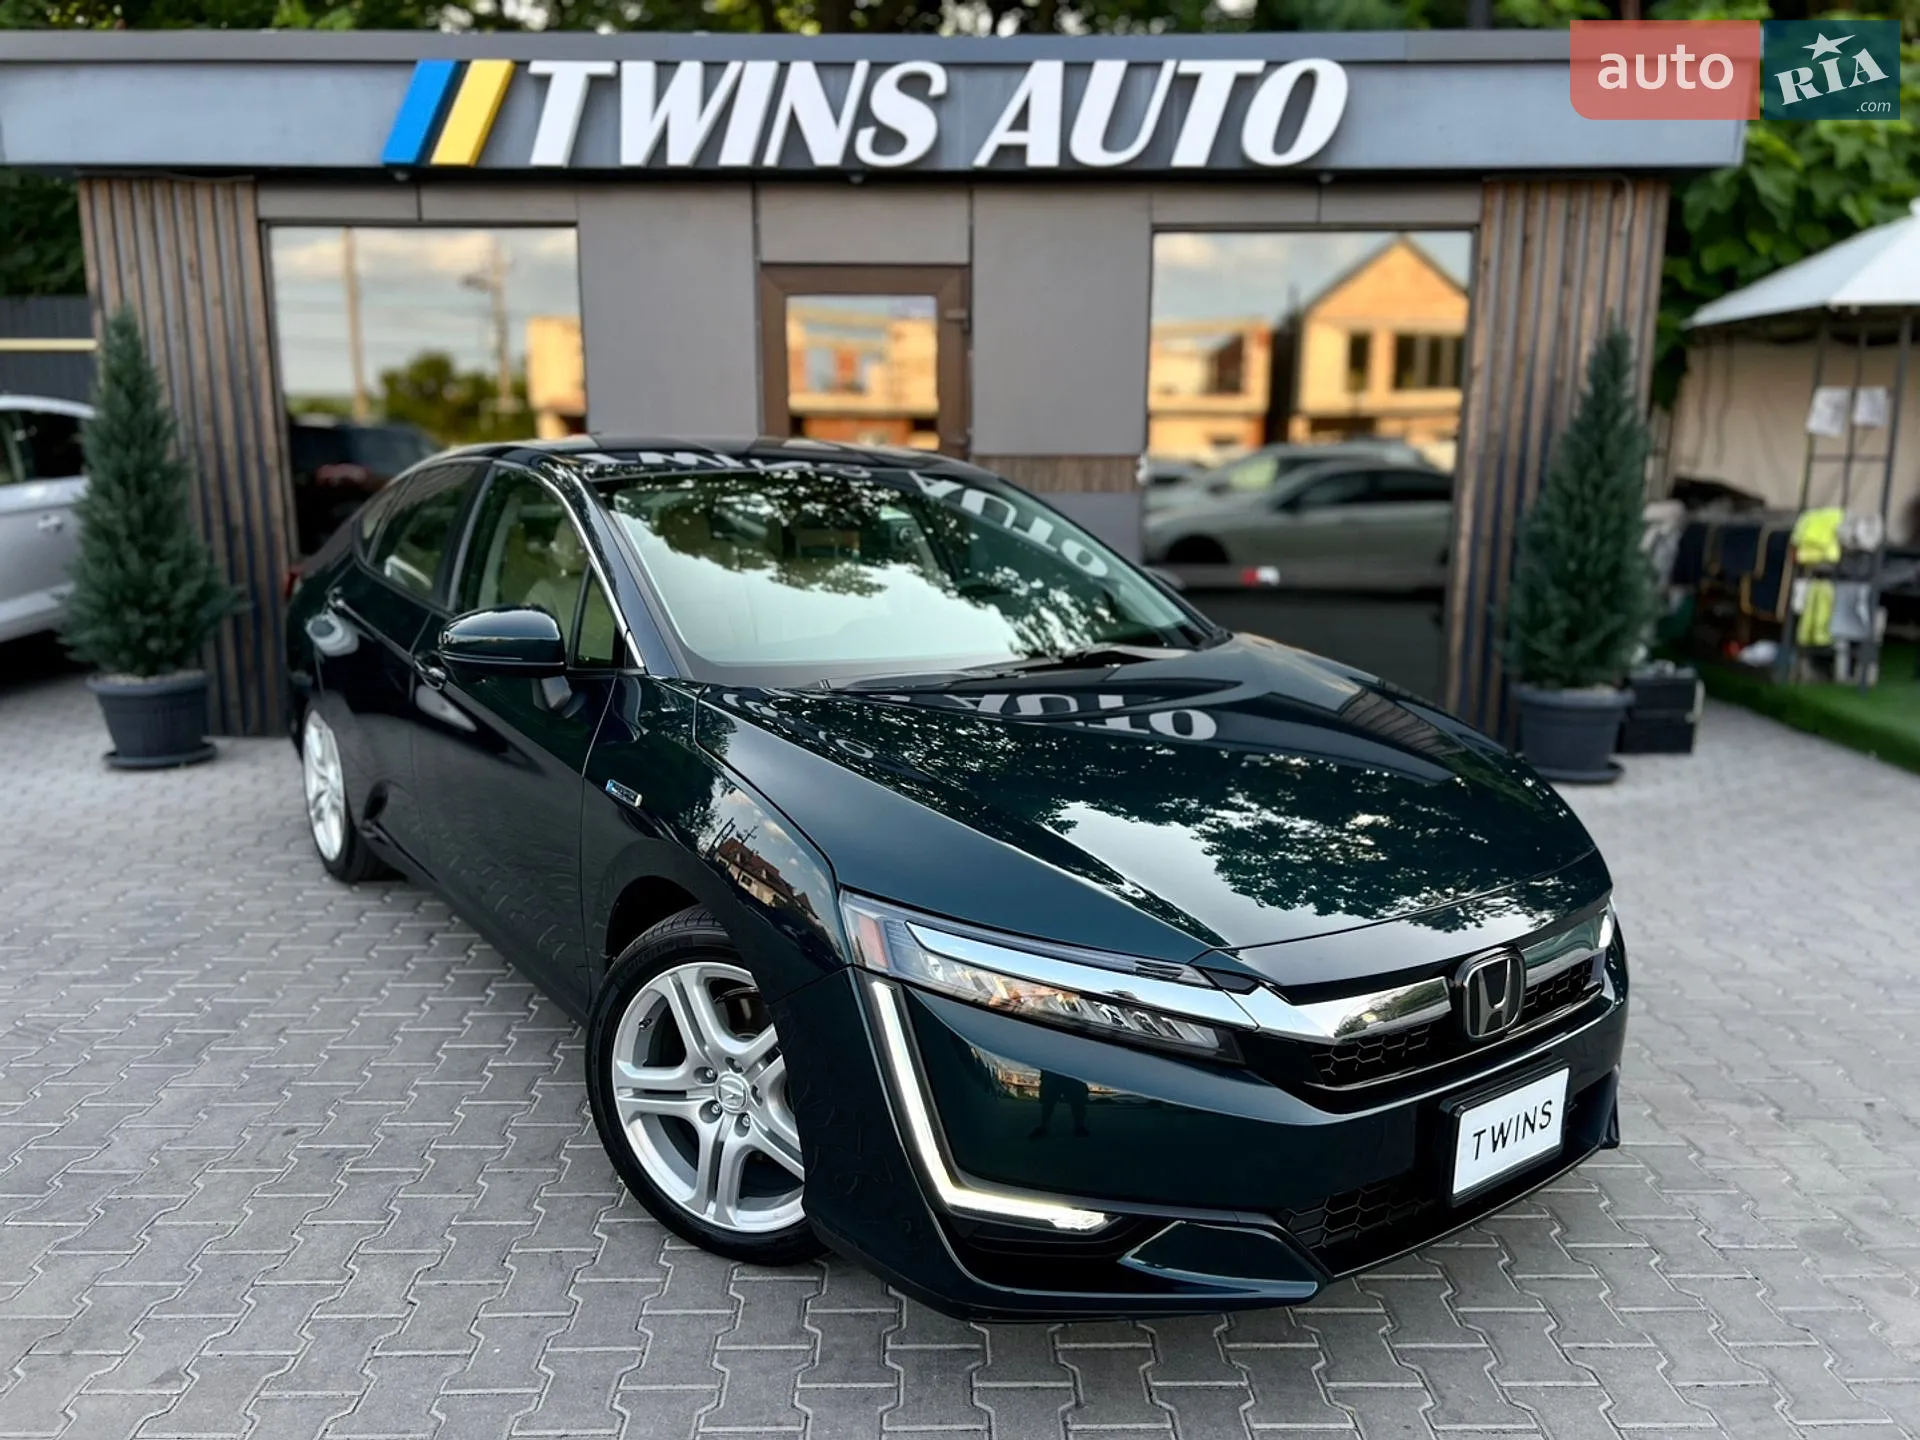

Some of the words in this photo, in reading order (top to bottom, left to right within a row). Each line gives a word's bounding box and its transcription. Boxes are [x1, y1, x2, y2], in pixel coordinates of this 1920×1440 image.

[528, 59, 948, 168] TWINS
[972, 58, 1349, 168] AUTO
[1472, 1099, 1552, 1160] TWINS
